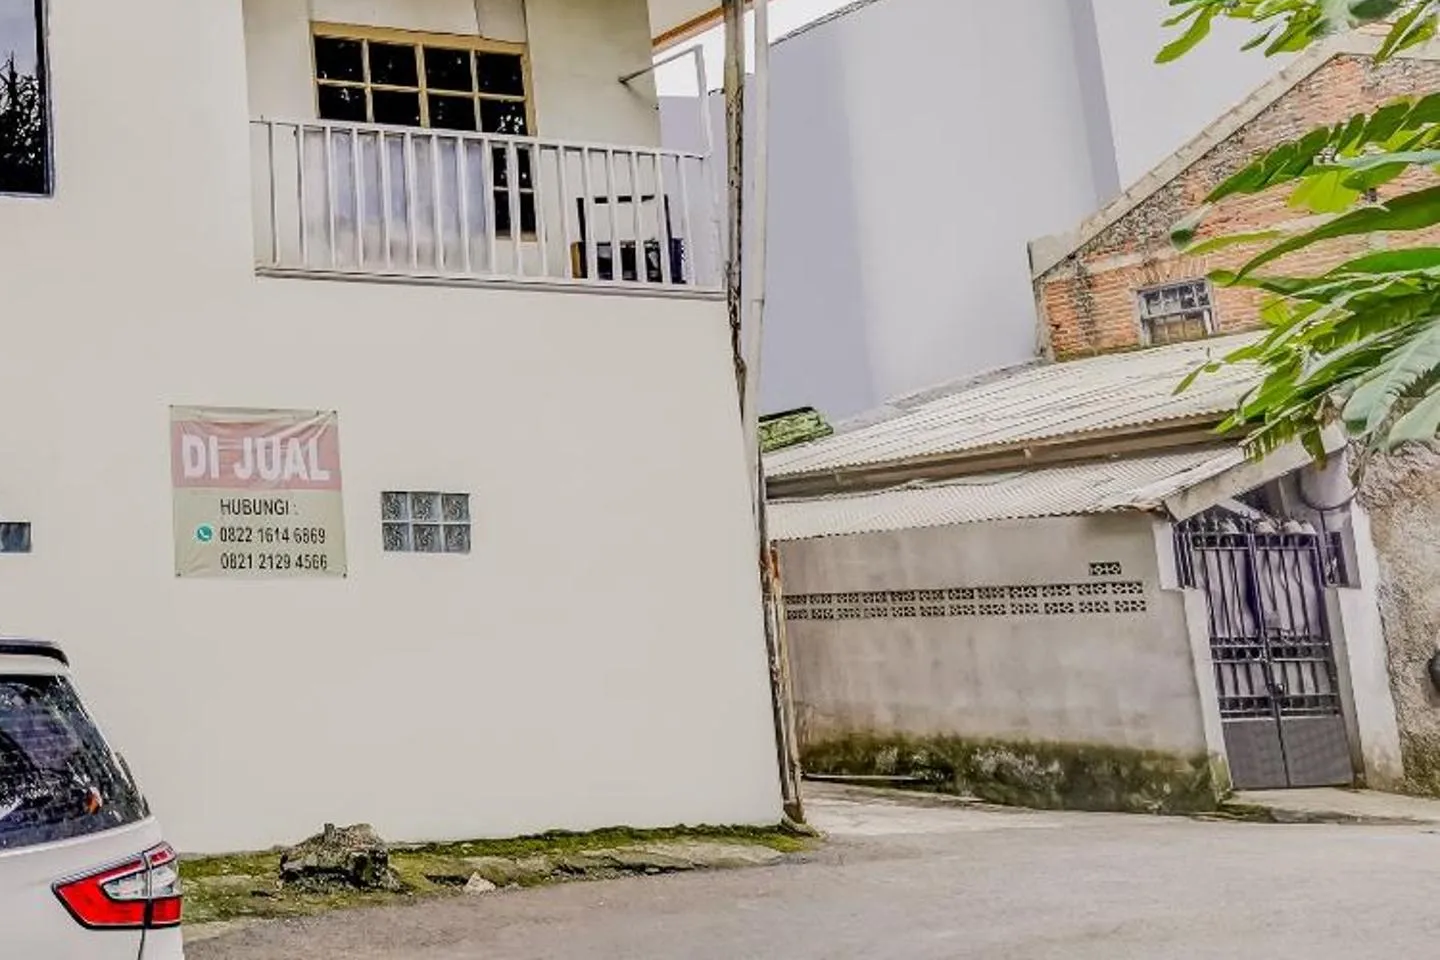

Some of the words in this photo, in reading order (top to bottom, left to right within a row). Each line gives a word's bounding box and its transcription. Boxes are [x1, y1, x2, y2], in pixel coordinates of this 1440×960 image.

[181, 434, 220, 480] DI
[233, 436, 331, 482] JUAL
[220, 498, 289, 515] HUBUNGI
[220, 526, 252, 542] 0822
[257, 526, 290, 543] 1614
[220, 552, 252, 569] 0821
[258, 552, 291, 569] 2129
